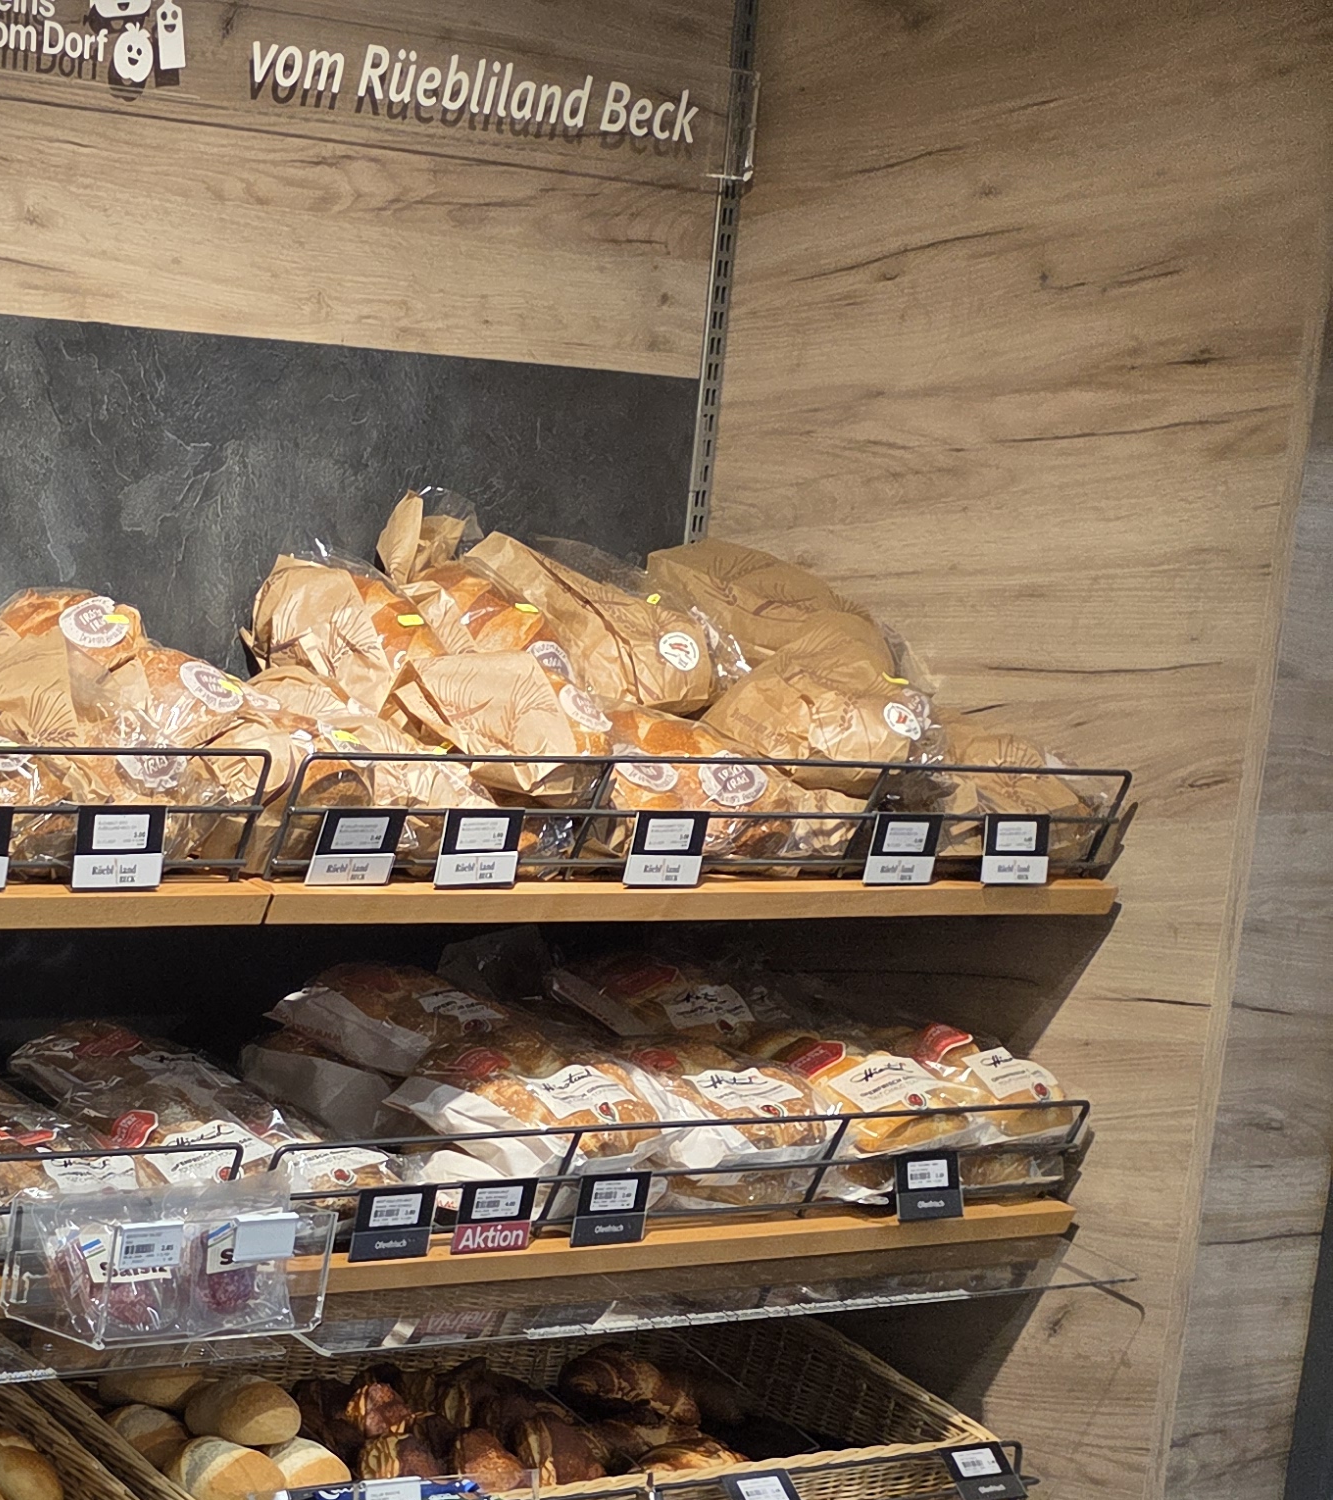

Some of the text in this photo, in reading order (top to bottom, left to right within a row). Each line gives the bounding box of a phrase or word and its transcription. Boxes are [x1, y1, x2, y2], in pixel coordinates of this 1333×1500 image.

[43, 20, 108, 62] Dorf
[252, 40, 700, 144] vom Rüebliland Beck
[459, 1224, 523, 1249] Aktion
